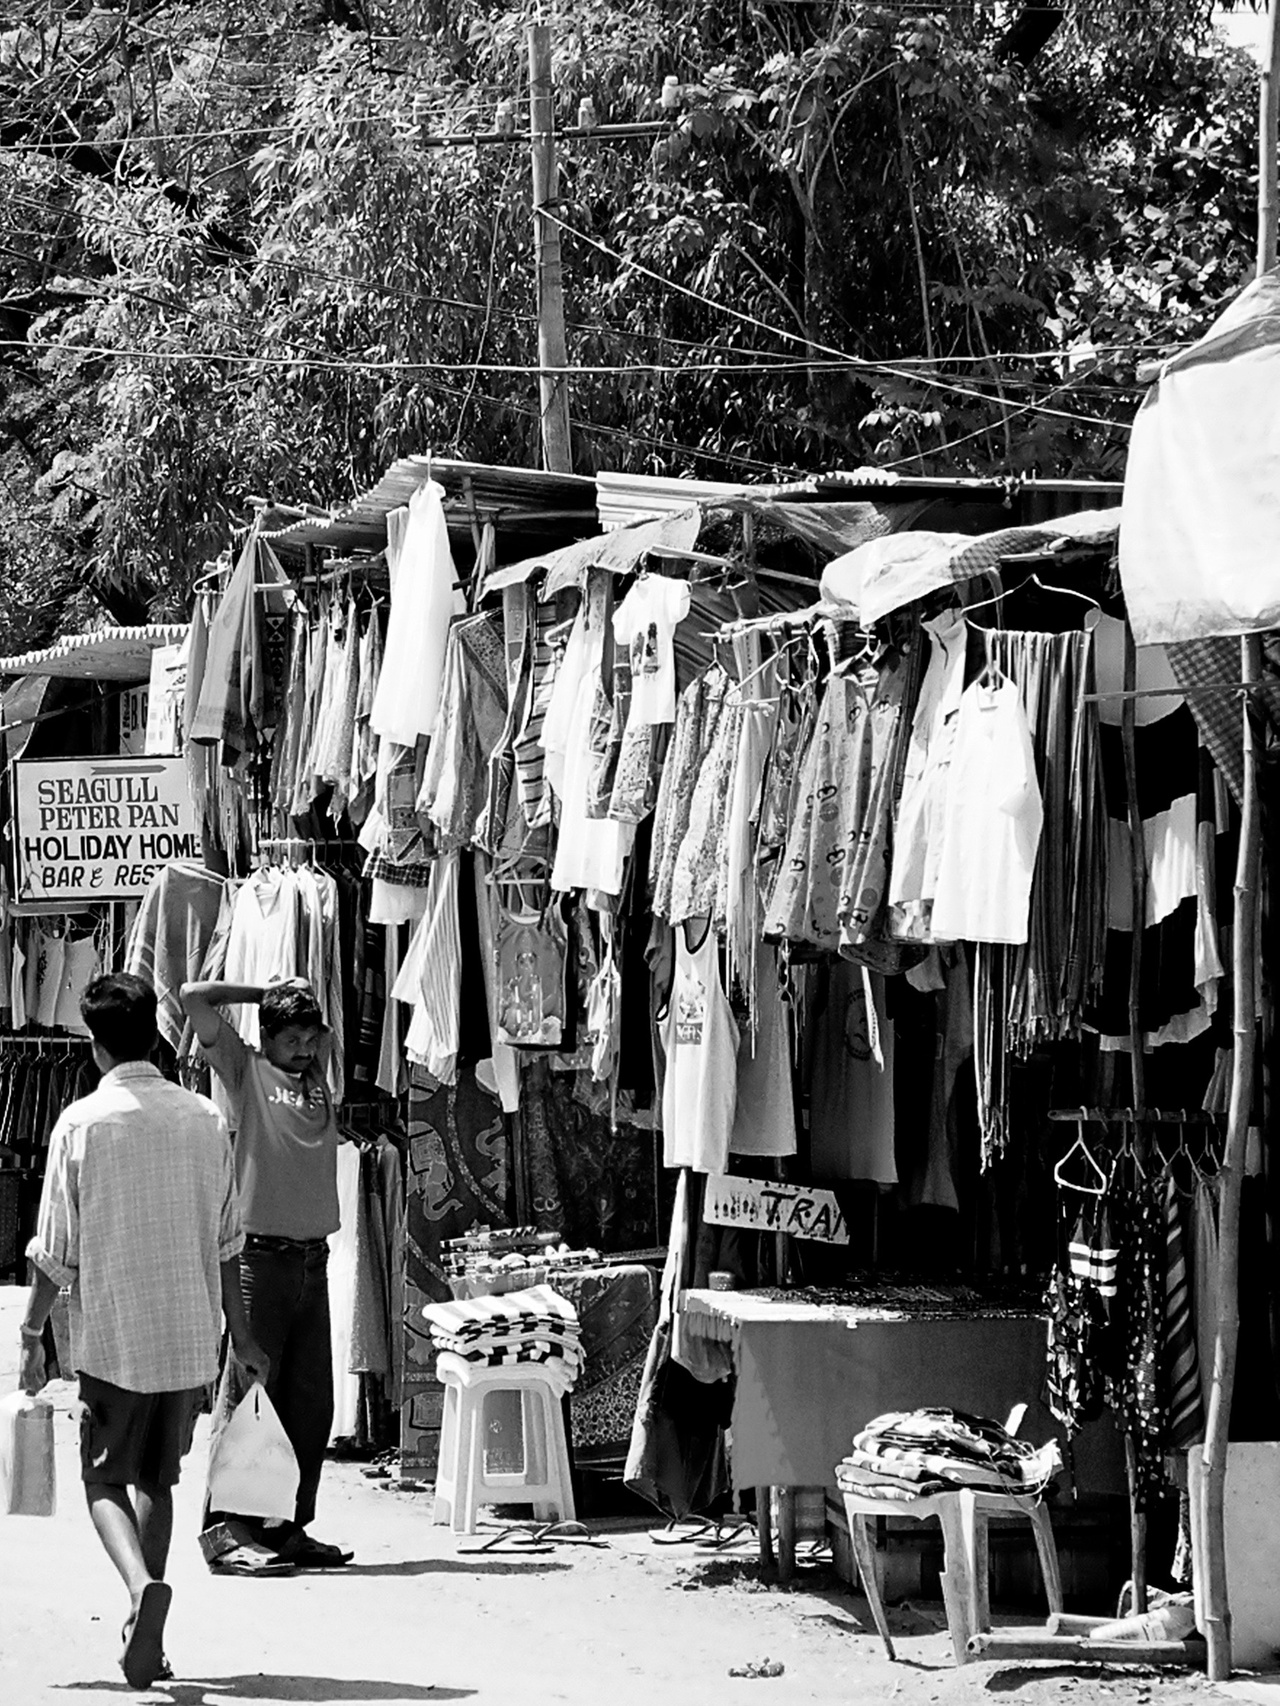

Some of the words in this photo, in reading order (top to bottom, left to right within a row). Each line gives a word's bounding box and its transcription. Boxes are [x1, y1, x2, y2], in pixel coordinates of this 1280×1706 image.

[38, 777, 158, 805] SEAGULL
[39, 805, 122, 831] PETER
[126, 803, 180, 828] PAN
[25, 834, 133, 862] HOLIDAY
[139, 833, 203, 860] HOME
[42, 866, 85, 888] BAR
